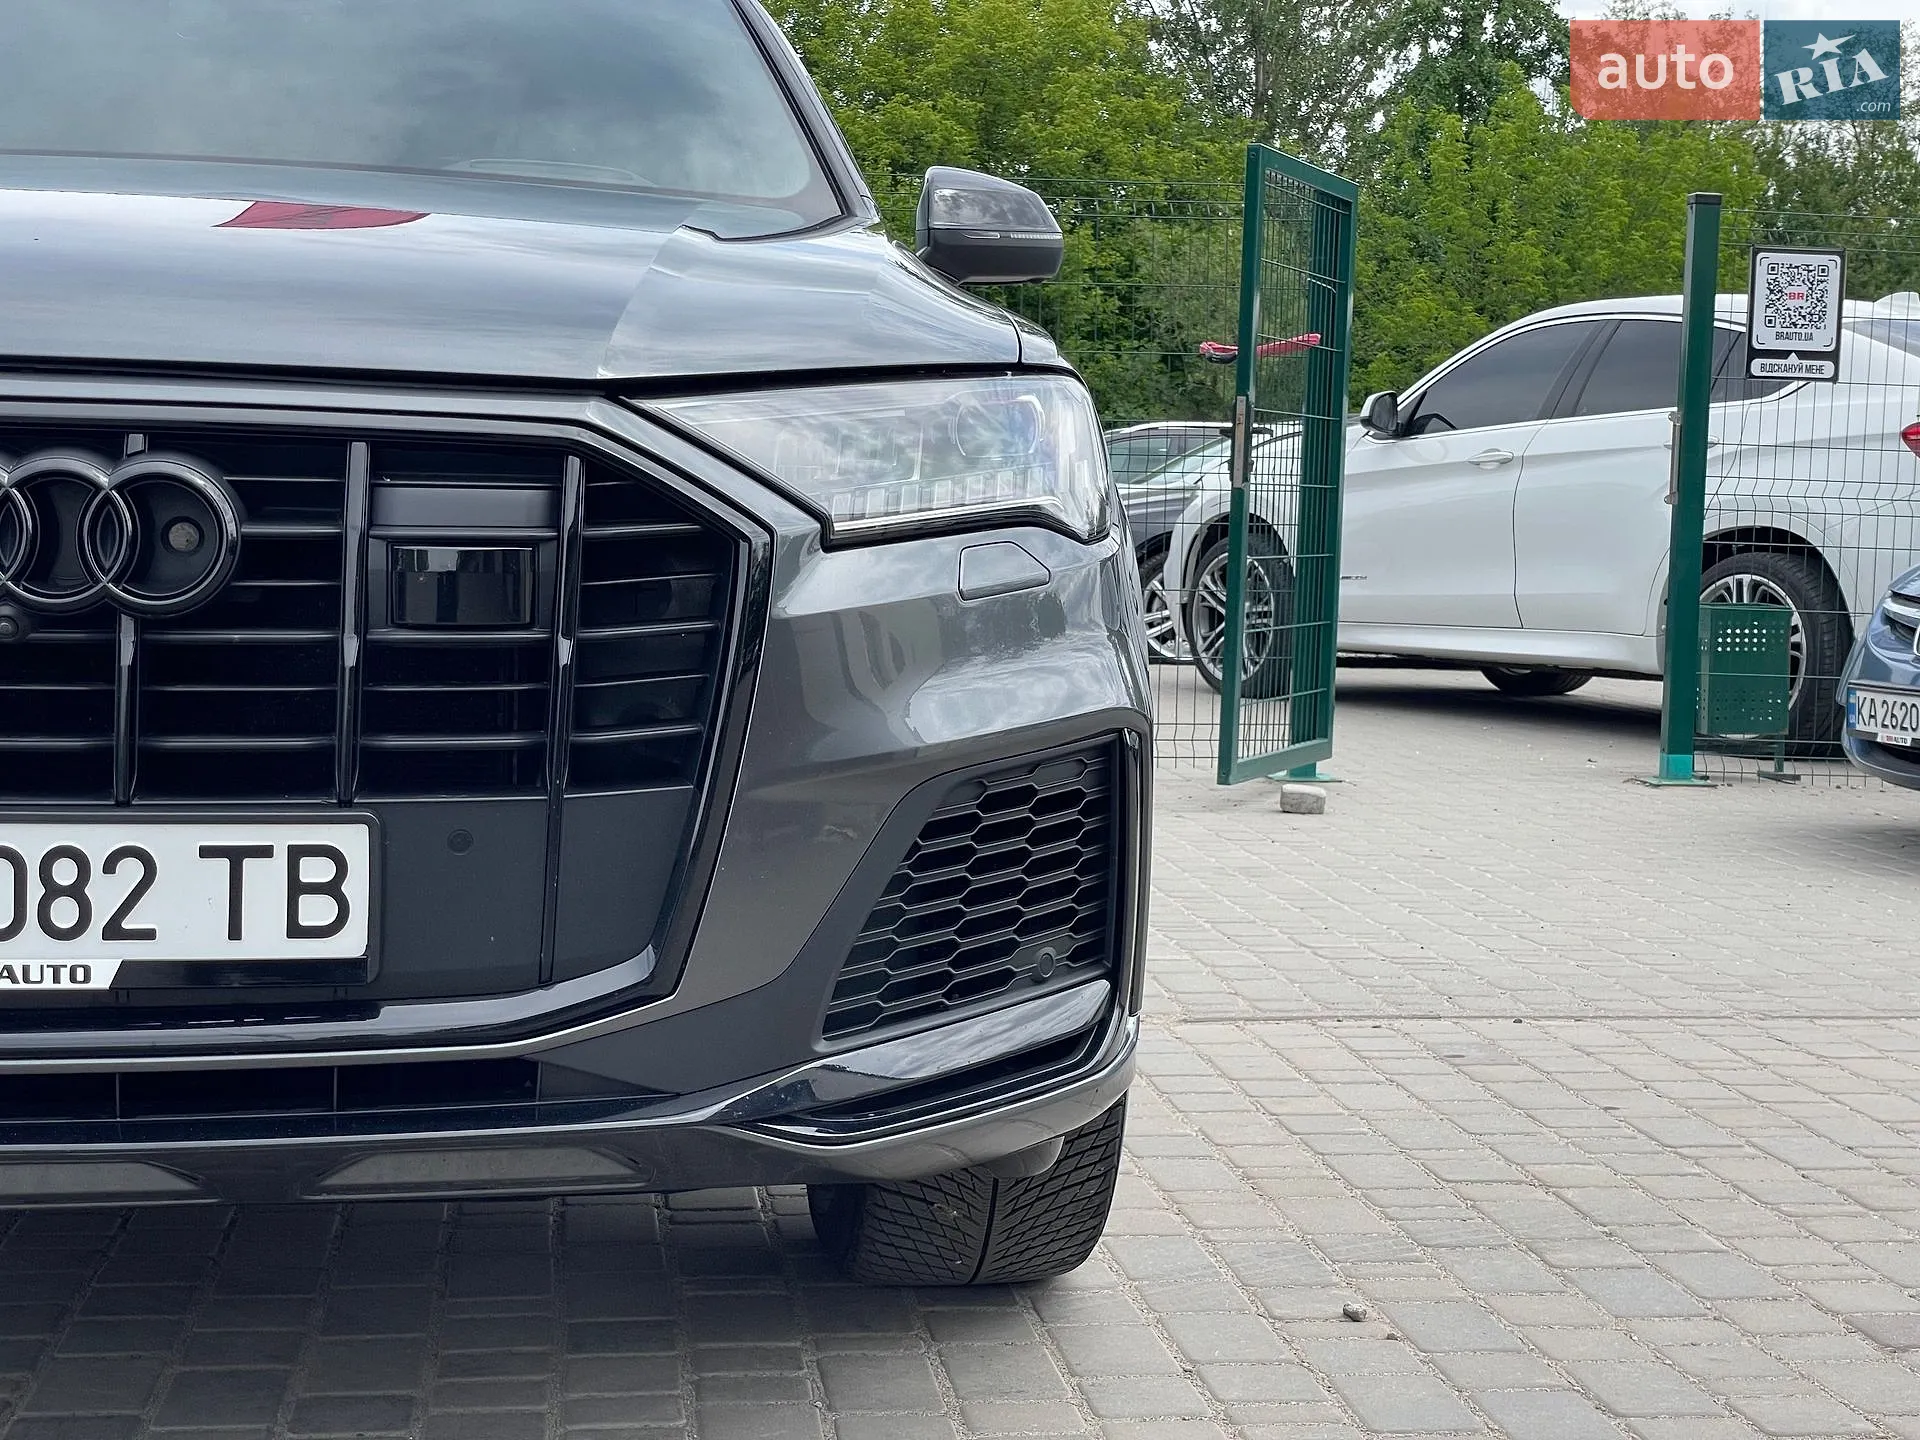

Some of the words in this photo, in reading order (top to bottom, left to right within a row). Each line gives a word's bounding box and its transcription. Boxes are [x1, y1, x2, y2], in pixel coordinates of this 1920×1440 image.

[1788, 292, 1805, 301] BR
[1775, 331, 1814, 342] BRAUTO.UA
[1760, 362, 1803, 374] ВІДСКАНУЙ
[1805, 364, 1825, 375] МЕНЕ
[198, 844, 351, 941] TB
[0, 964, 92, 985] AUTO
